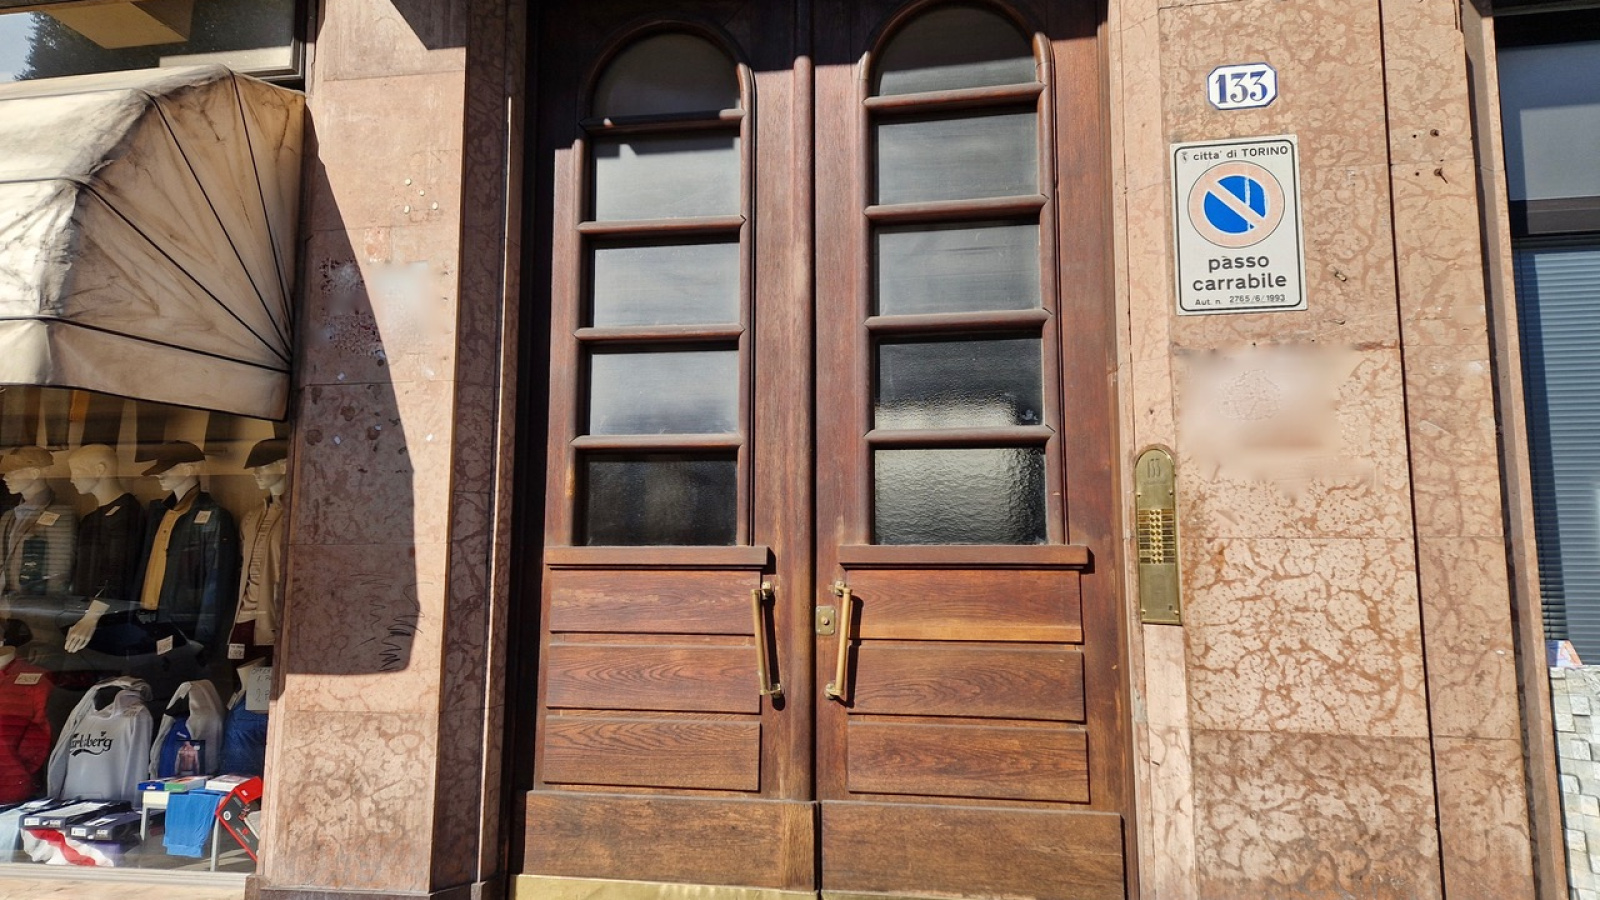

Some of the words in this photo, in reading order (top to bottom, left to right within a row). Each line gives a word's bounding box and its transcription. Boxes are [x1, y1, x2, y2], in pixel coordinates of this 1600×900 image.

[1215, 70, 1268, 104] 133
[1193, 150, 1222, 161] citta'
[1226, 149, 1237, 159] di
[1241, 146, 1288, 158] TORINO
[1208, 255, 1270, 273] passo
[1192, 272, 1287, 292] carrabile
[70, 732, 114, 756] arlsberg
